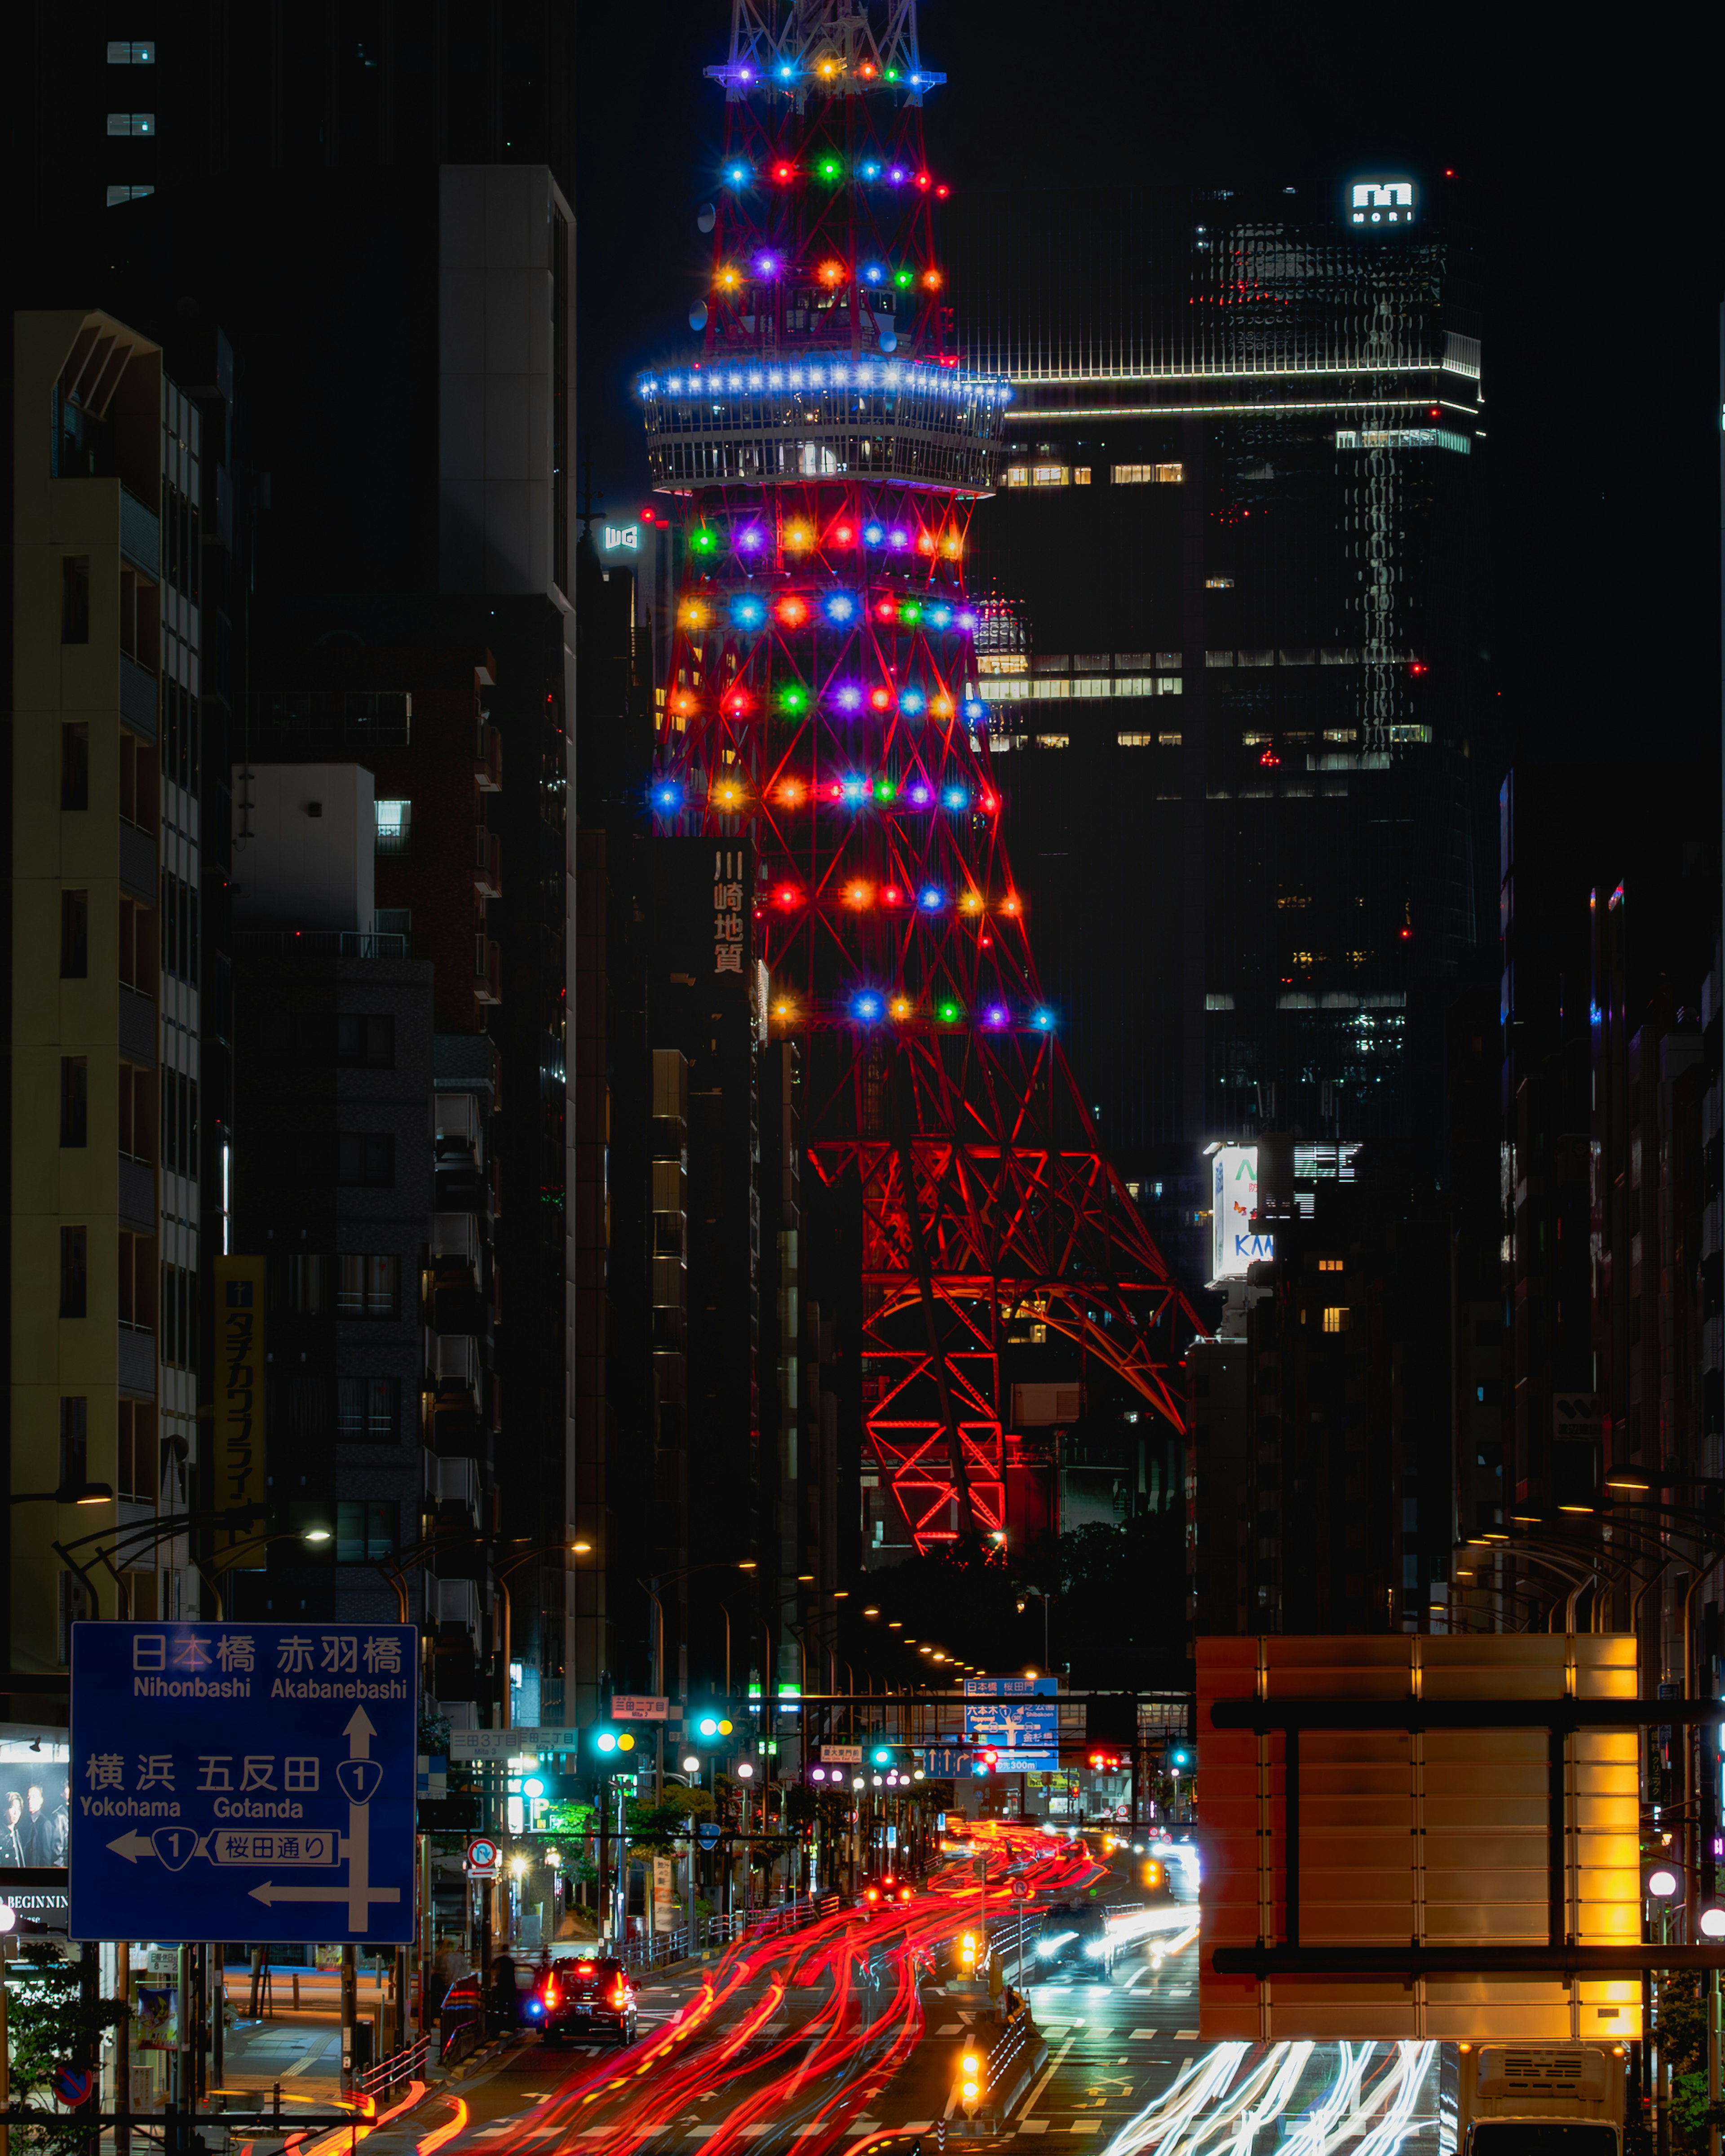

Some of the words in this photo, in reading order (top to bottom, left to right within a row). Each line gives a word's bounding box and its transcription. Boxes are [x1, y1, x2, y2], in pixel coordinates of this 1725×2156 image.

[1353, 212, 1413, 223] MORI
[605, 526, 637, 549] WG
[713, 850, 743, 974] 川崎地質
[226, 1313, 254, 1544] タチカワブライ
[133, 1634, 255, 1672] 日本橋
[277, 1635, 402, 1673] 赤羽橋
[134, 1677, 251, 1698] Nihonbashi
[271, 1678, 406, 1699] Akabanebashi
[968, 1682, 997, 1692] 日本橋
[1004, 1682, 1035, 1691] 桜田門
[615, 1701, 664, 1711] 三田二丁目
[967, 1705, 998, 1715] 六本木
[454, 1734, 517, 1747] 三田3丁目
[85, 1753, 175, 1791] 横浜
[197, 1756, 319, 1792] 五反田
[353, 1767, 364, 1790] 1
[80, 1797, 181, 1817] Yokohama
[214, 1797, 303, 1818] Gotanda
[168, 1833, 179, 1857] 1
[226, 1837, 324, 1860] 桜田通り
